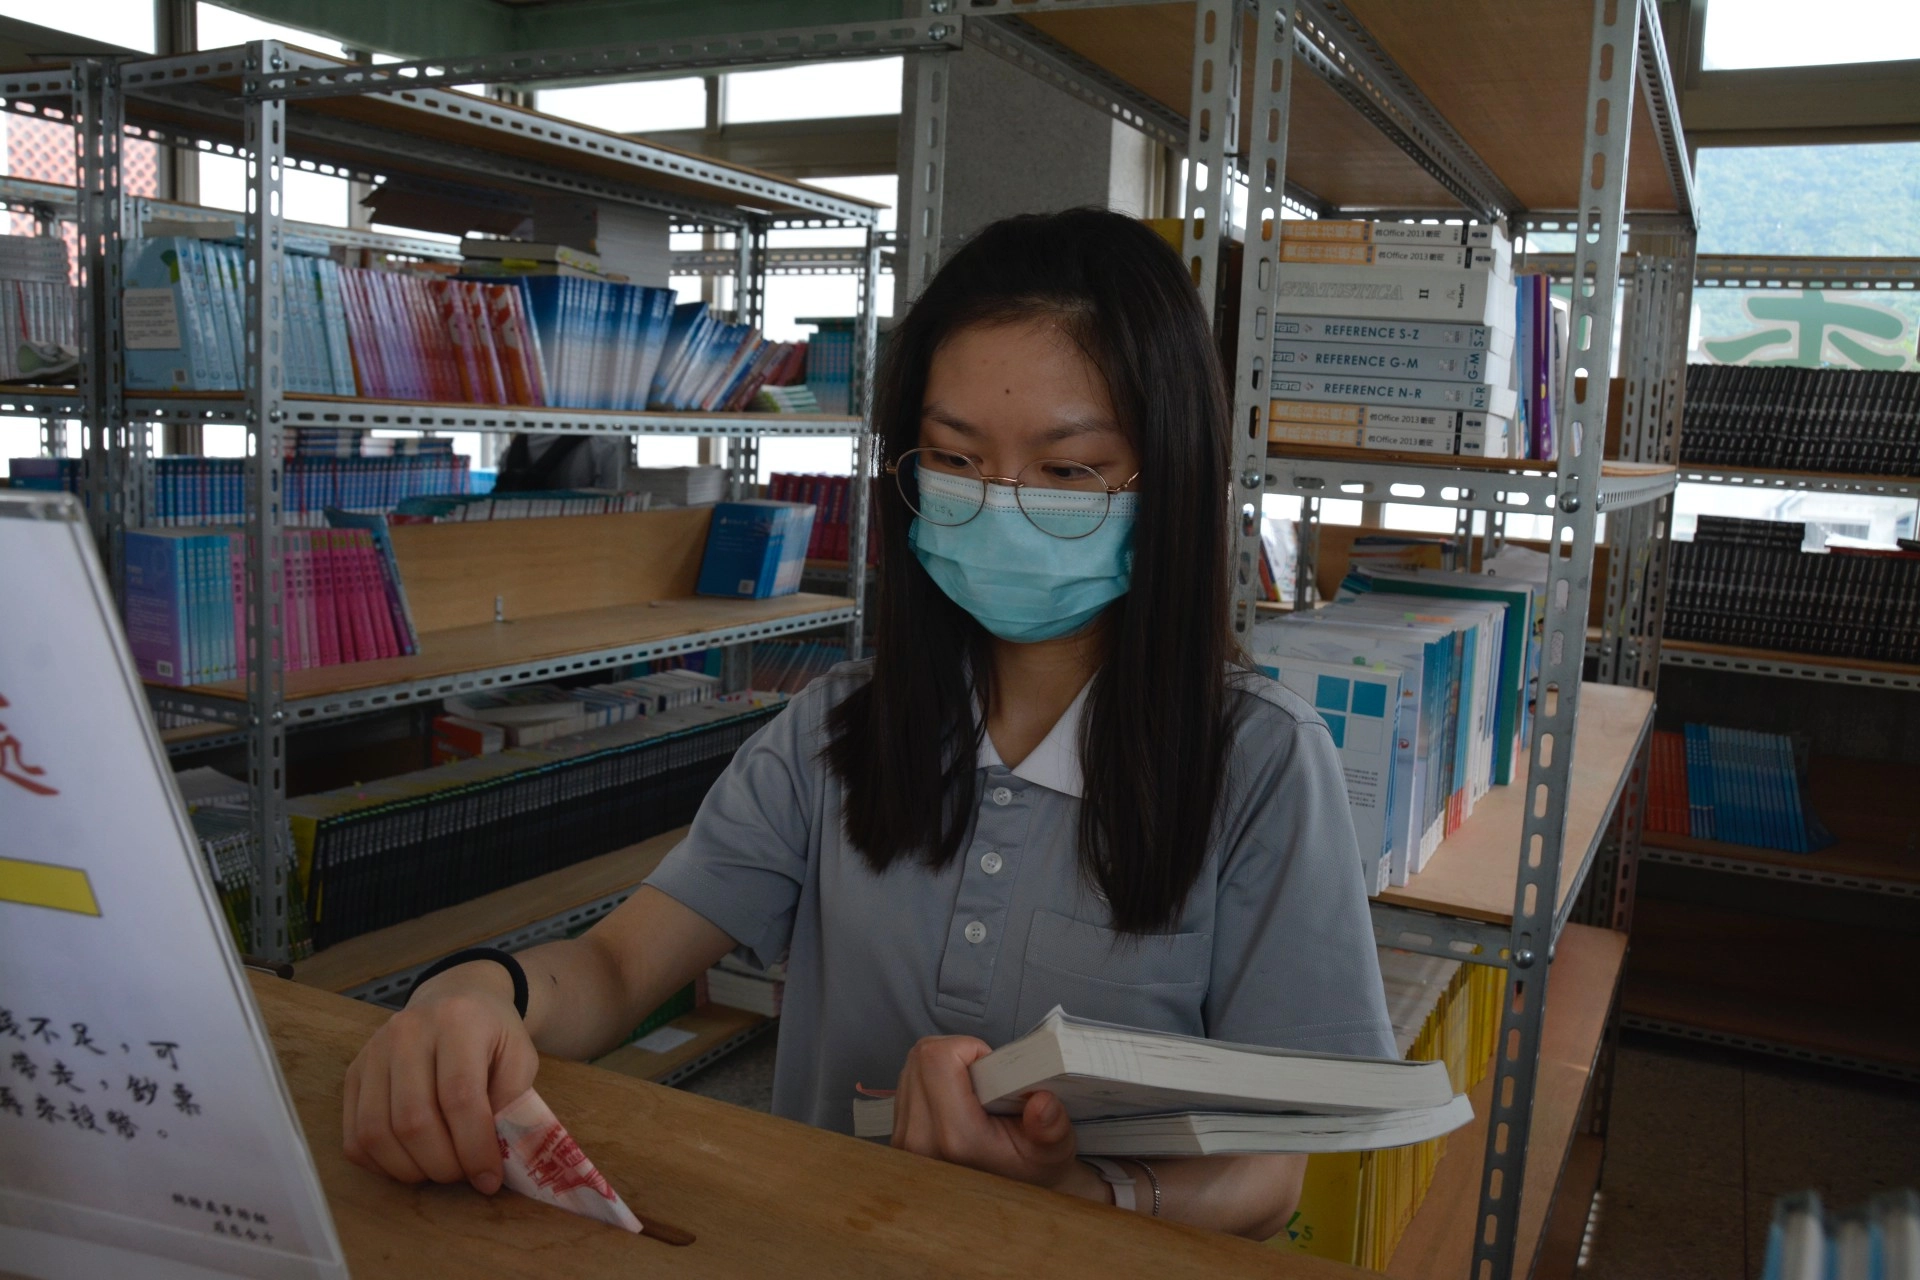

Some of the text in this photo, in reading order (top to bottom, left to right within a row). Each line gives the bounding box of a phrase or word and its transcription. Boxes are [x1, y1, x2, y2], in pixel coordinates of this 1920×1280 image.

[1324, 324, 1420, 340] REFERENCE S-Z
[1473, 328, 1486, 348] S-Z
[1315, 353, 1419, 369] REFERENCE G-M
[1467, 353, 1480, 379] G-M
[1324, 383, 1422, 399] REFERENCE N-R
[1474, 387, 1486, 408] N-R
